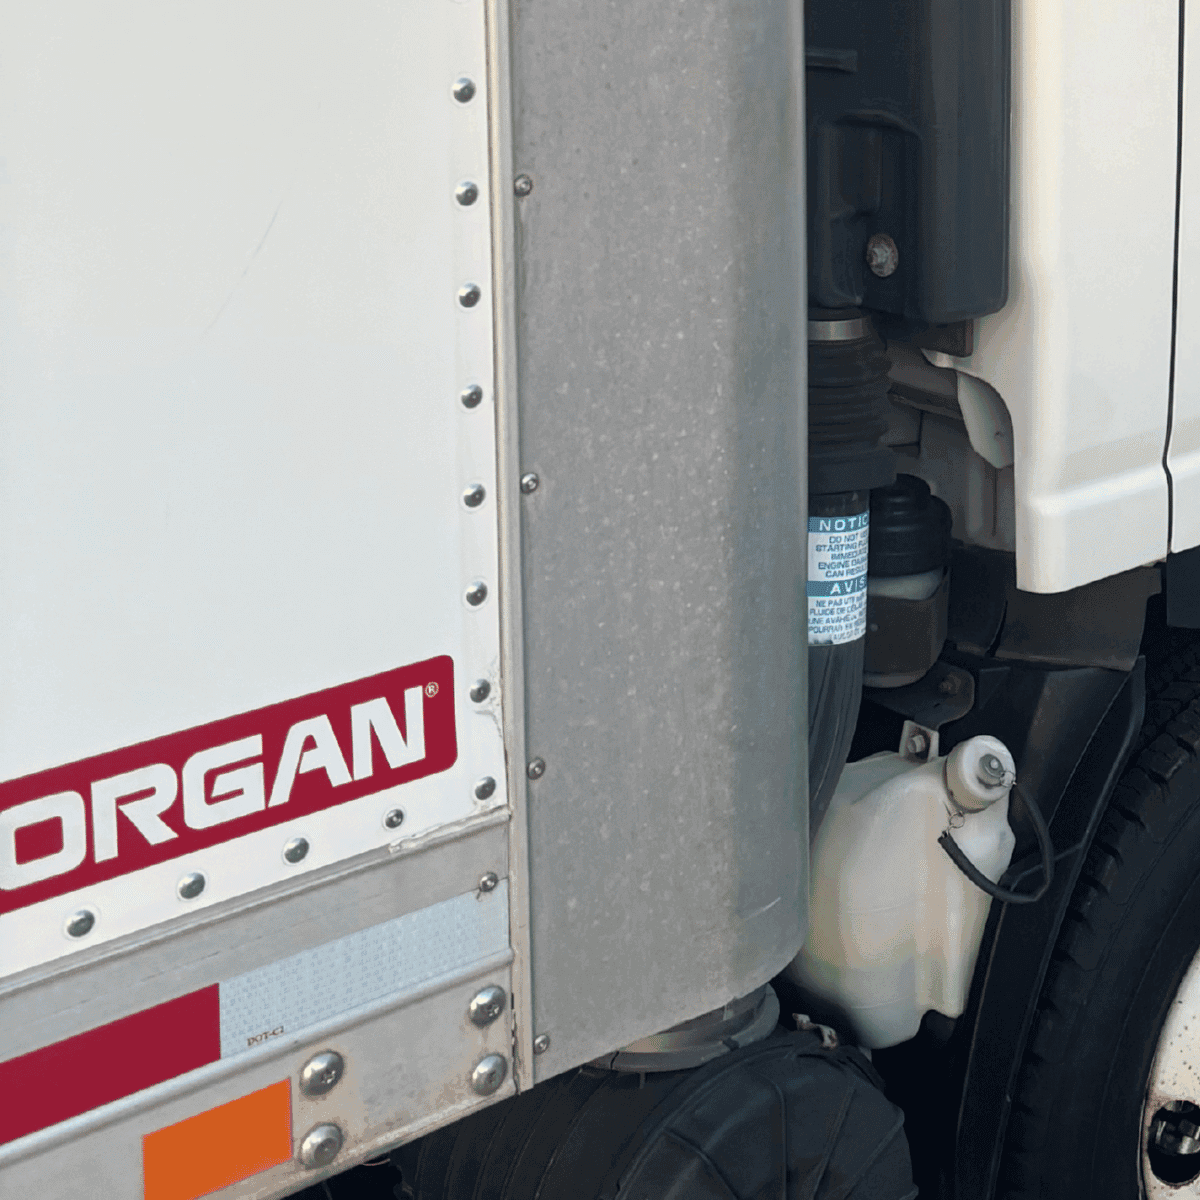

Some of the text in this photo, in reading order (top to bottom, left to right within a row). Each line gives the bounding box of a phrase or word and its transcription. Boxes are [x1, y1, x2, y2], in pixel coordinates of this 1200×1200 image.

[829, 536, 842, 544] DO
[844, 532, 859, 542] NOT
[815, 541, 858, 552] STARTING
[818, 560, 849, 570] ENGINE
[825, 569, 844, 578] CAN
[830, 576, 866, 595] AVIS
